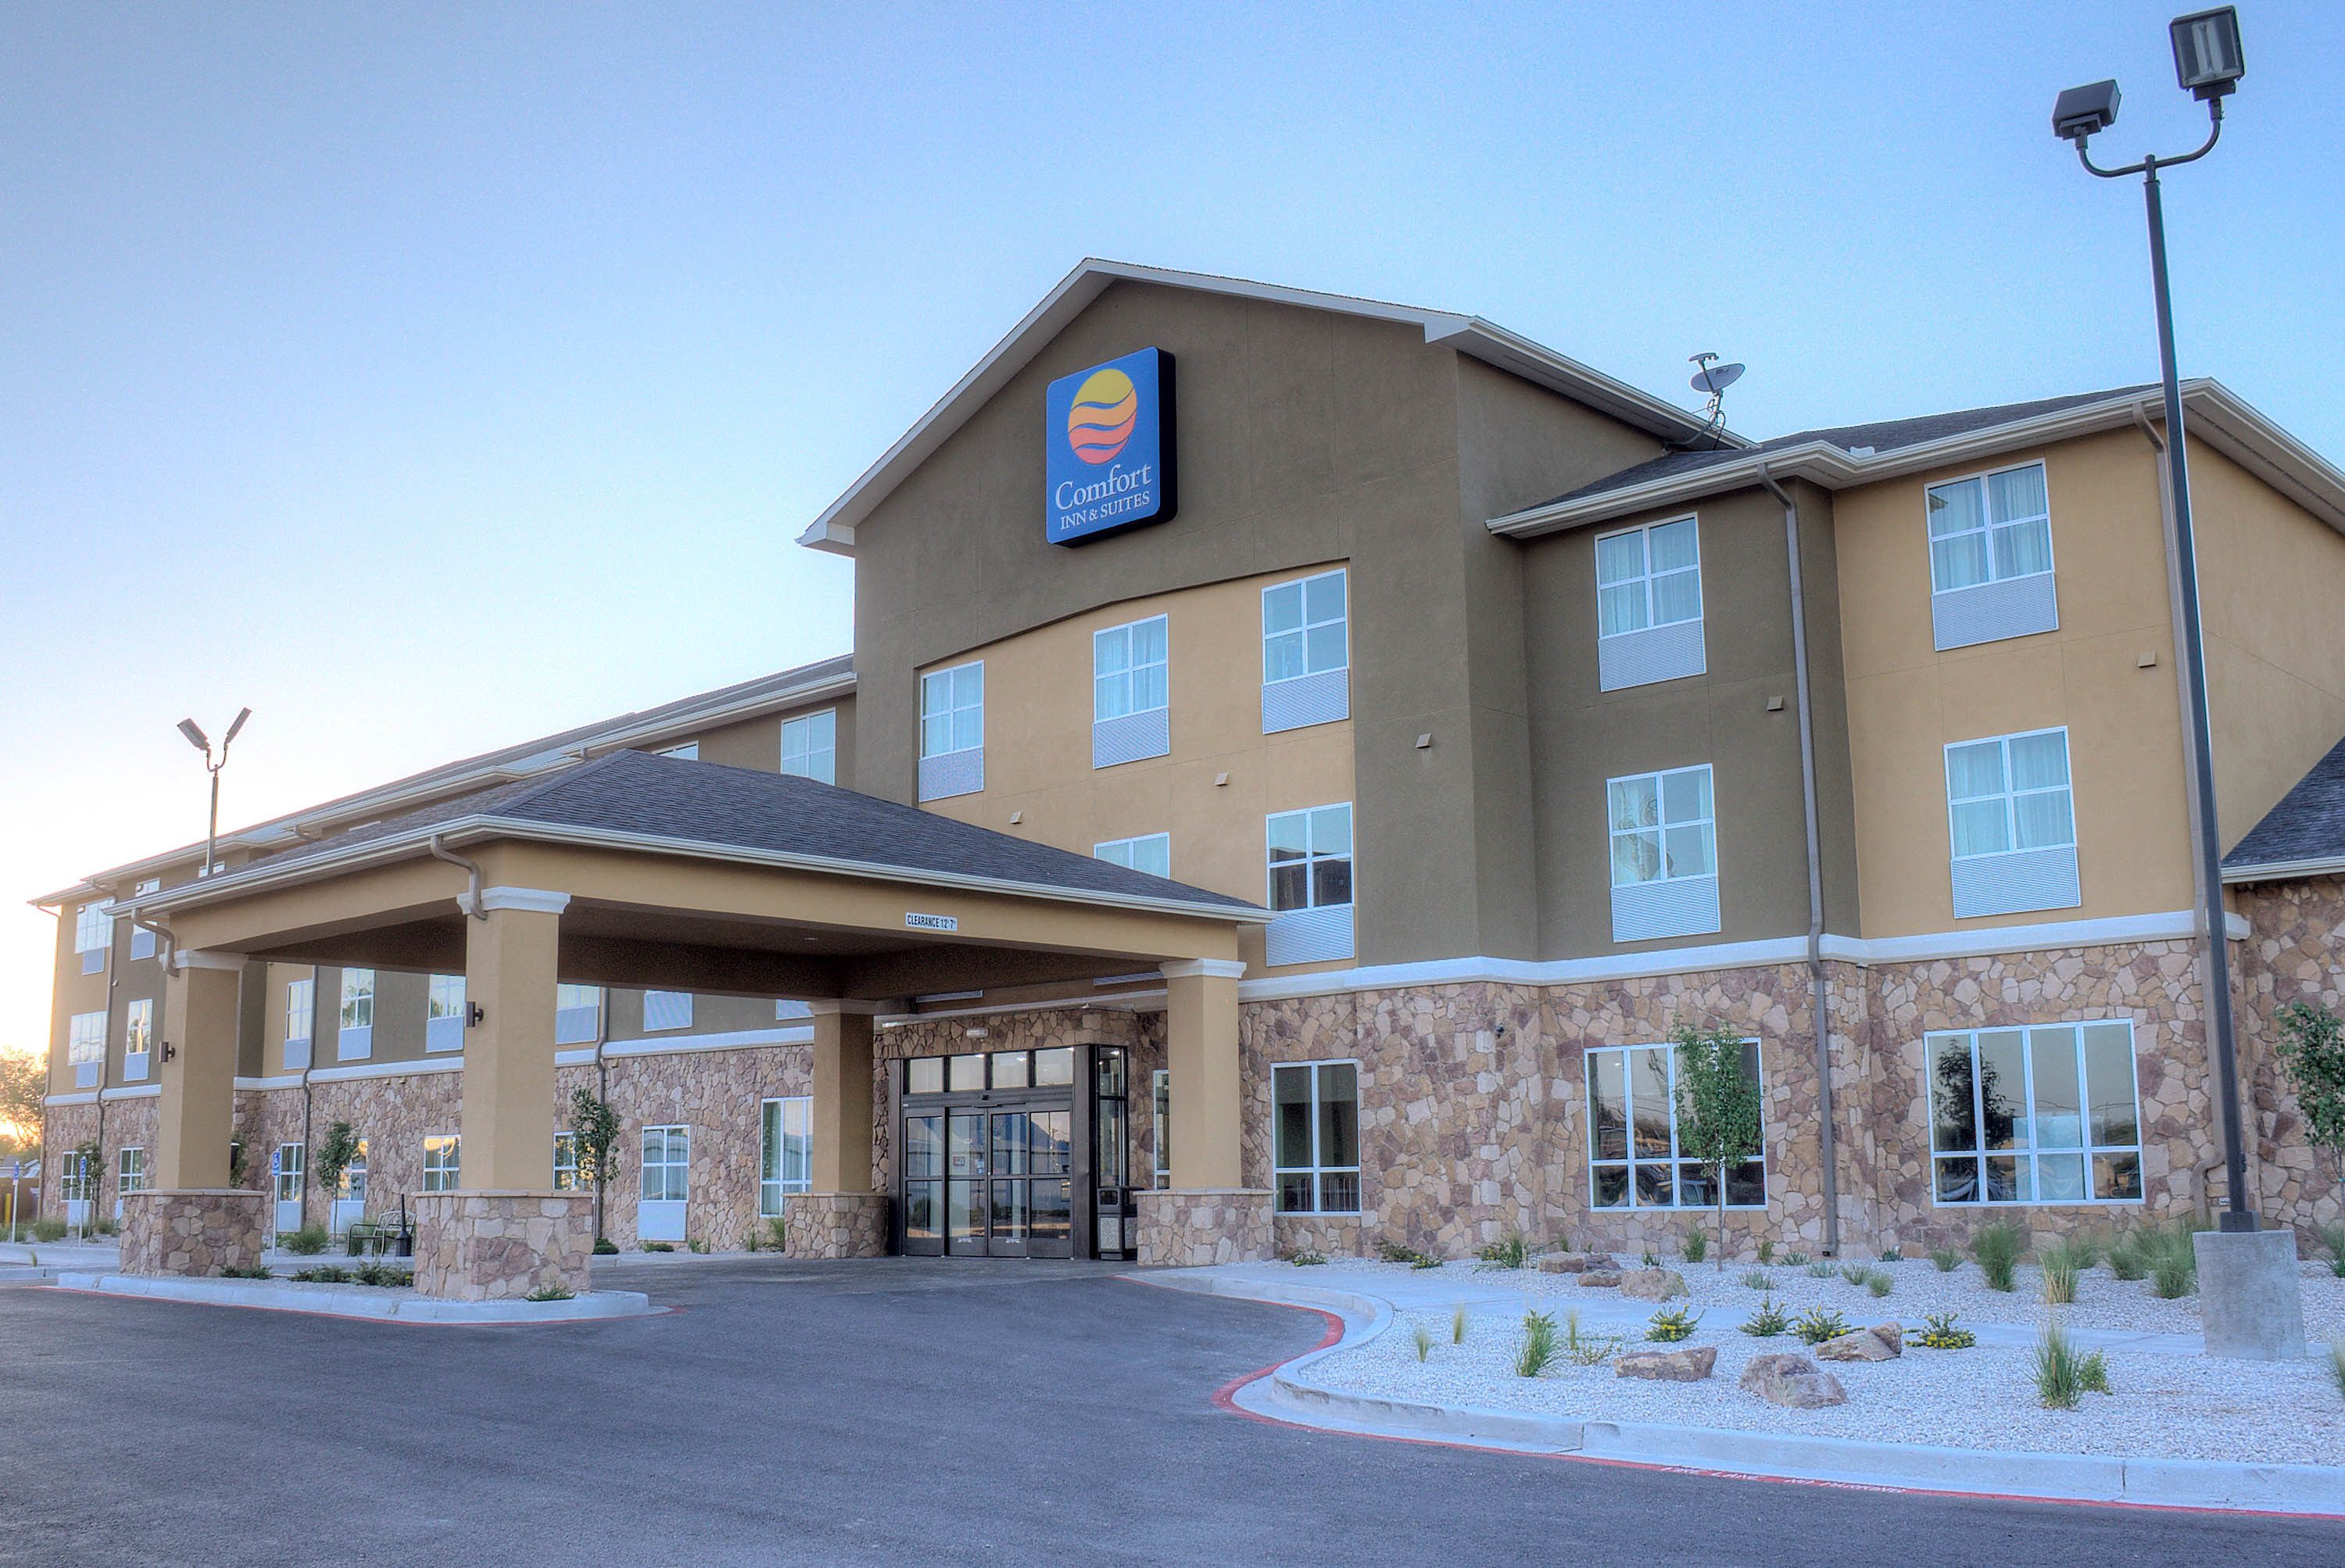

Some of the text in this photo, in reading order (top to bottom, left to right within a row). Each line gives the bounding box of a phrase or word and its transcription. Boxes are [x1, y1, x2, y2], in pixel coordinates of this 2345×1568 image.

[1055, 464, 1152, 510] Comfort
[1060, 491, 1151, 530] INN & SUITES
[908, 915, 939, 927] CLEARANCE
